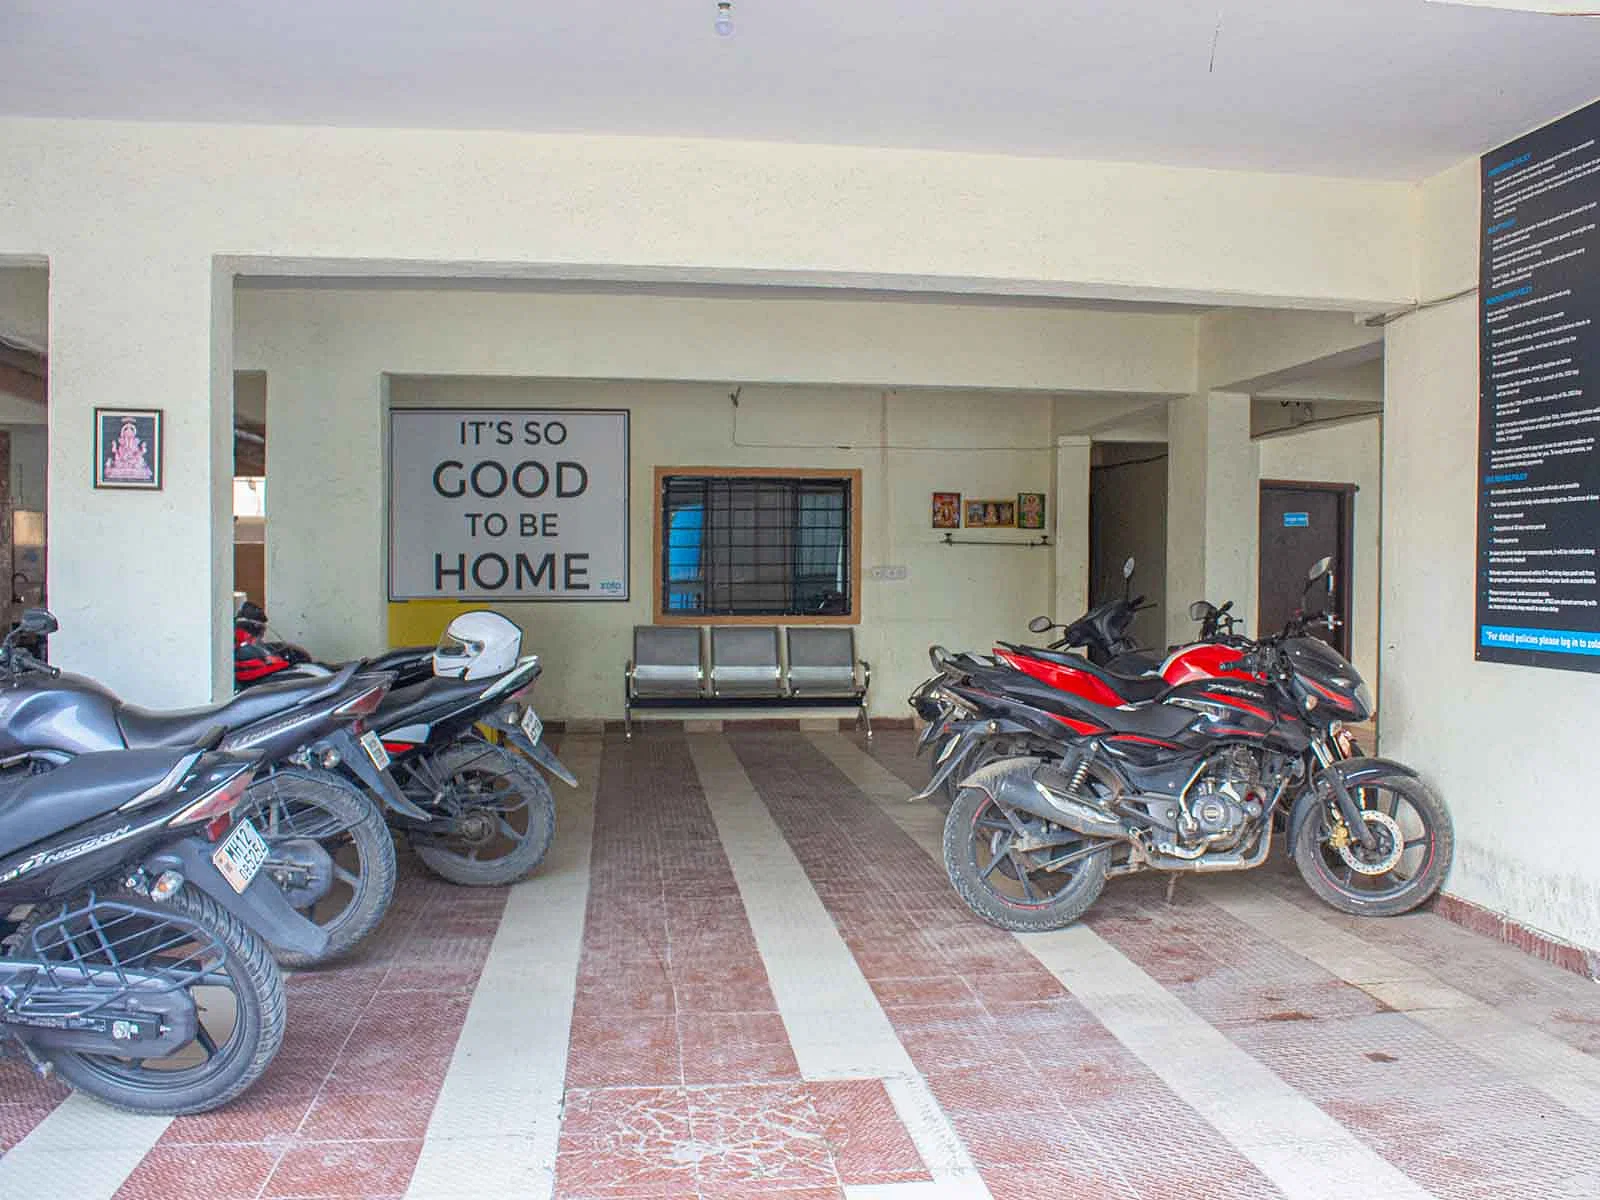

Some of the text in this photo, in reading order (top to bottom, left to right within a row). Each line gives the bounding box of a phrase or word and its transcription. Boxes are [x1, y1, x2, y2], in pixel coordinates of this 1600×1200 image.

[460, 420, 568, 446] IT'S SO
[432, 459, 589, 500] GOOD
[464, 512, 560, 537] TO BE
[434, 551, 591, 590] HOME
[1538, 635, 1560, 647] please
[224, 827, 252, 866] MH12
